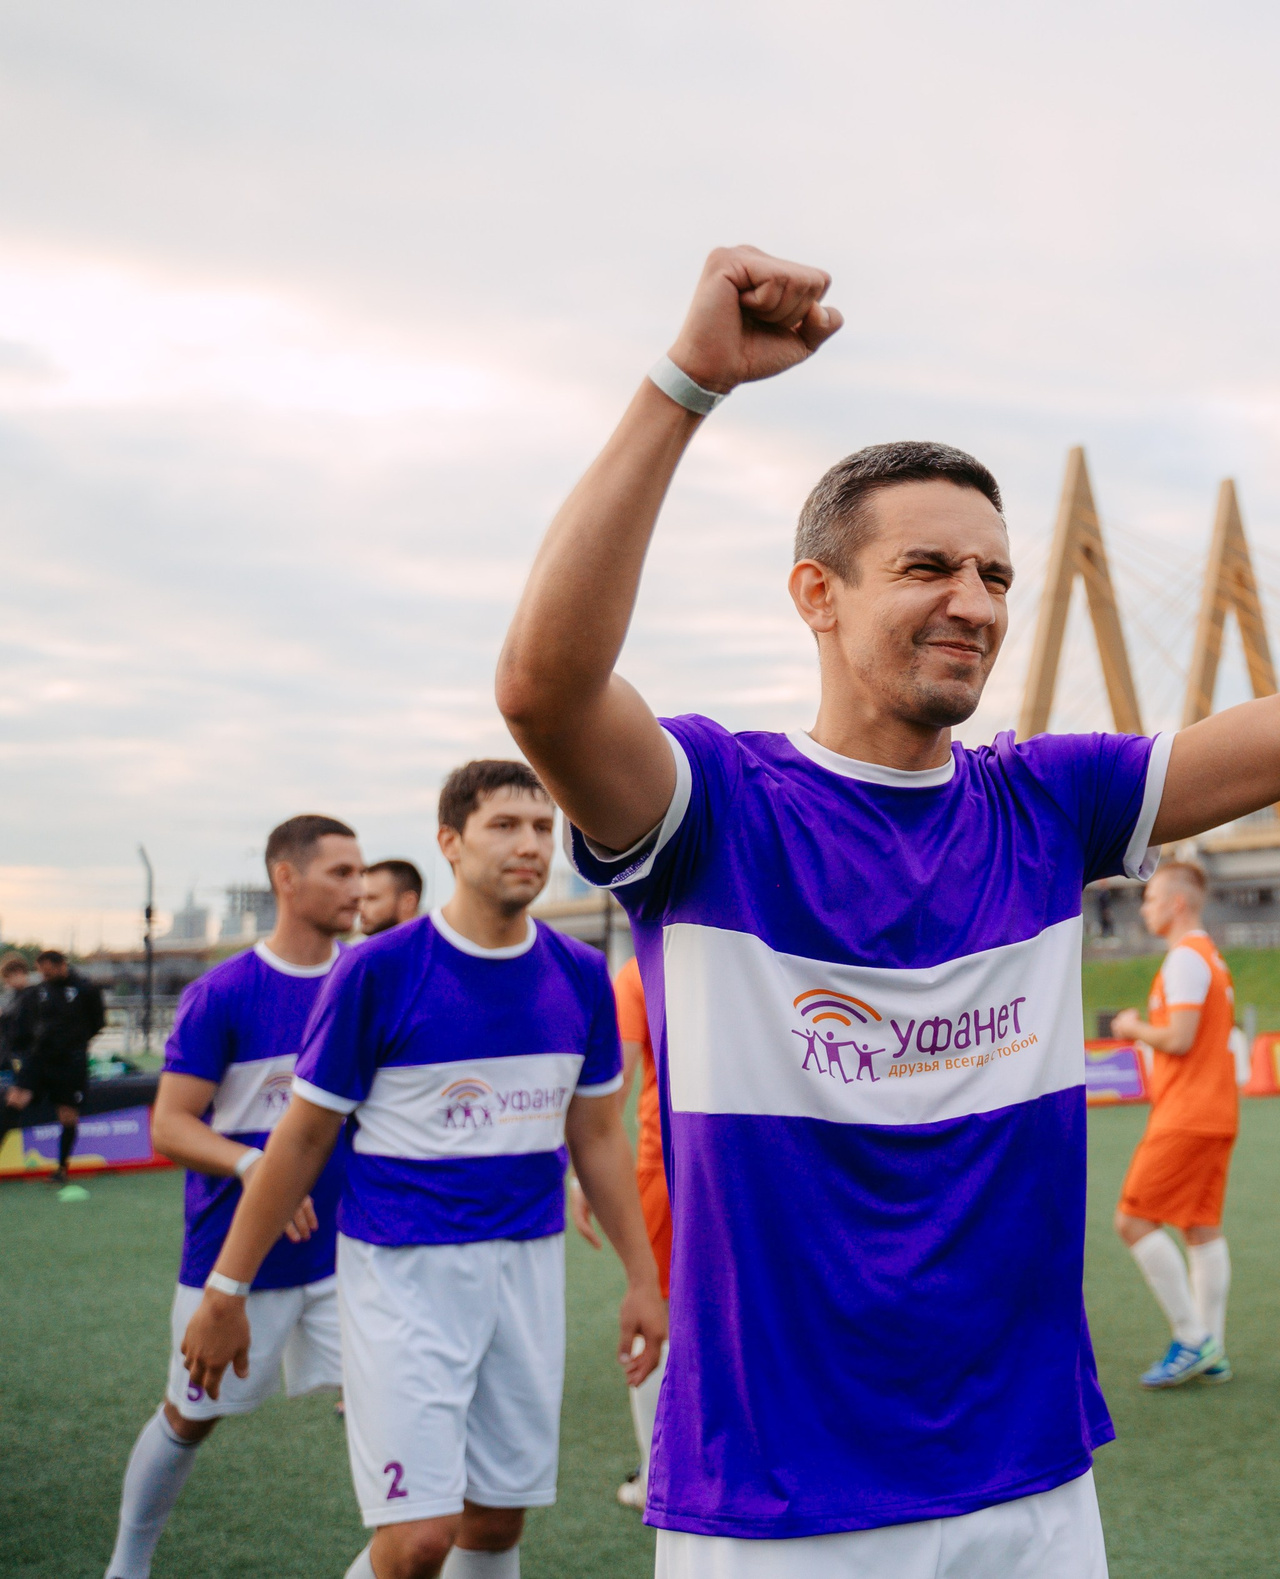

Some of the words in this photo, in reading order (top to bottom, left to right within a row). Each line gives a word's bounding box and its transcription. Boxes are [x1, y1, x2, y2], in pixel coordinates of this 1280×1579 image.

[888, 1060, 940, 1078] друзья
[945, 1053, 990, 1069] всегда
[997, 1032, 1039, 1058] тобой
[384, 1460, 408, 1501] 2
